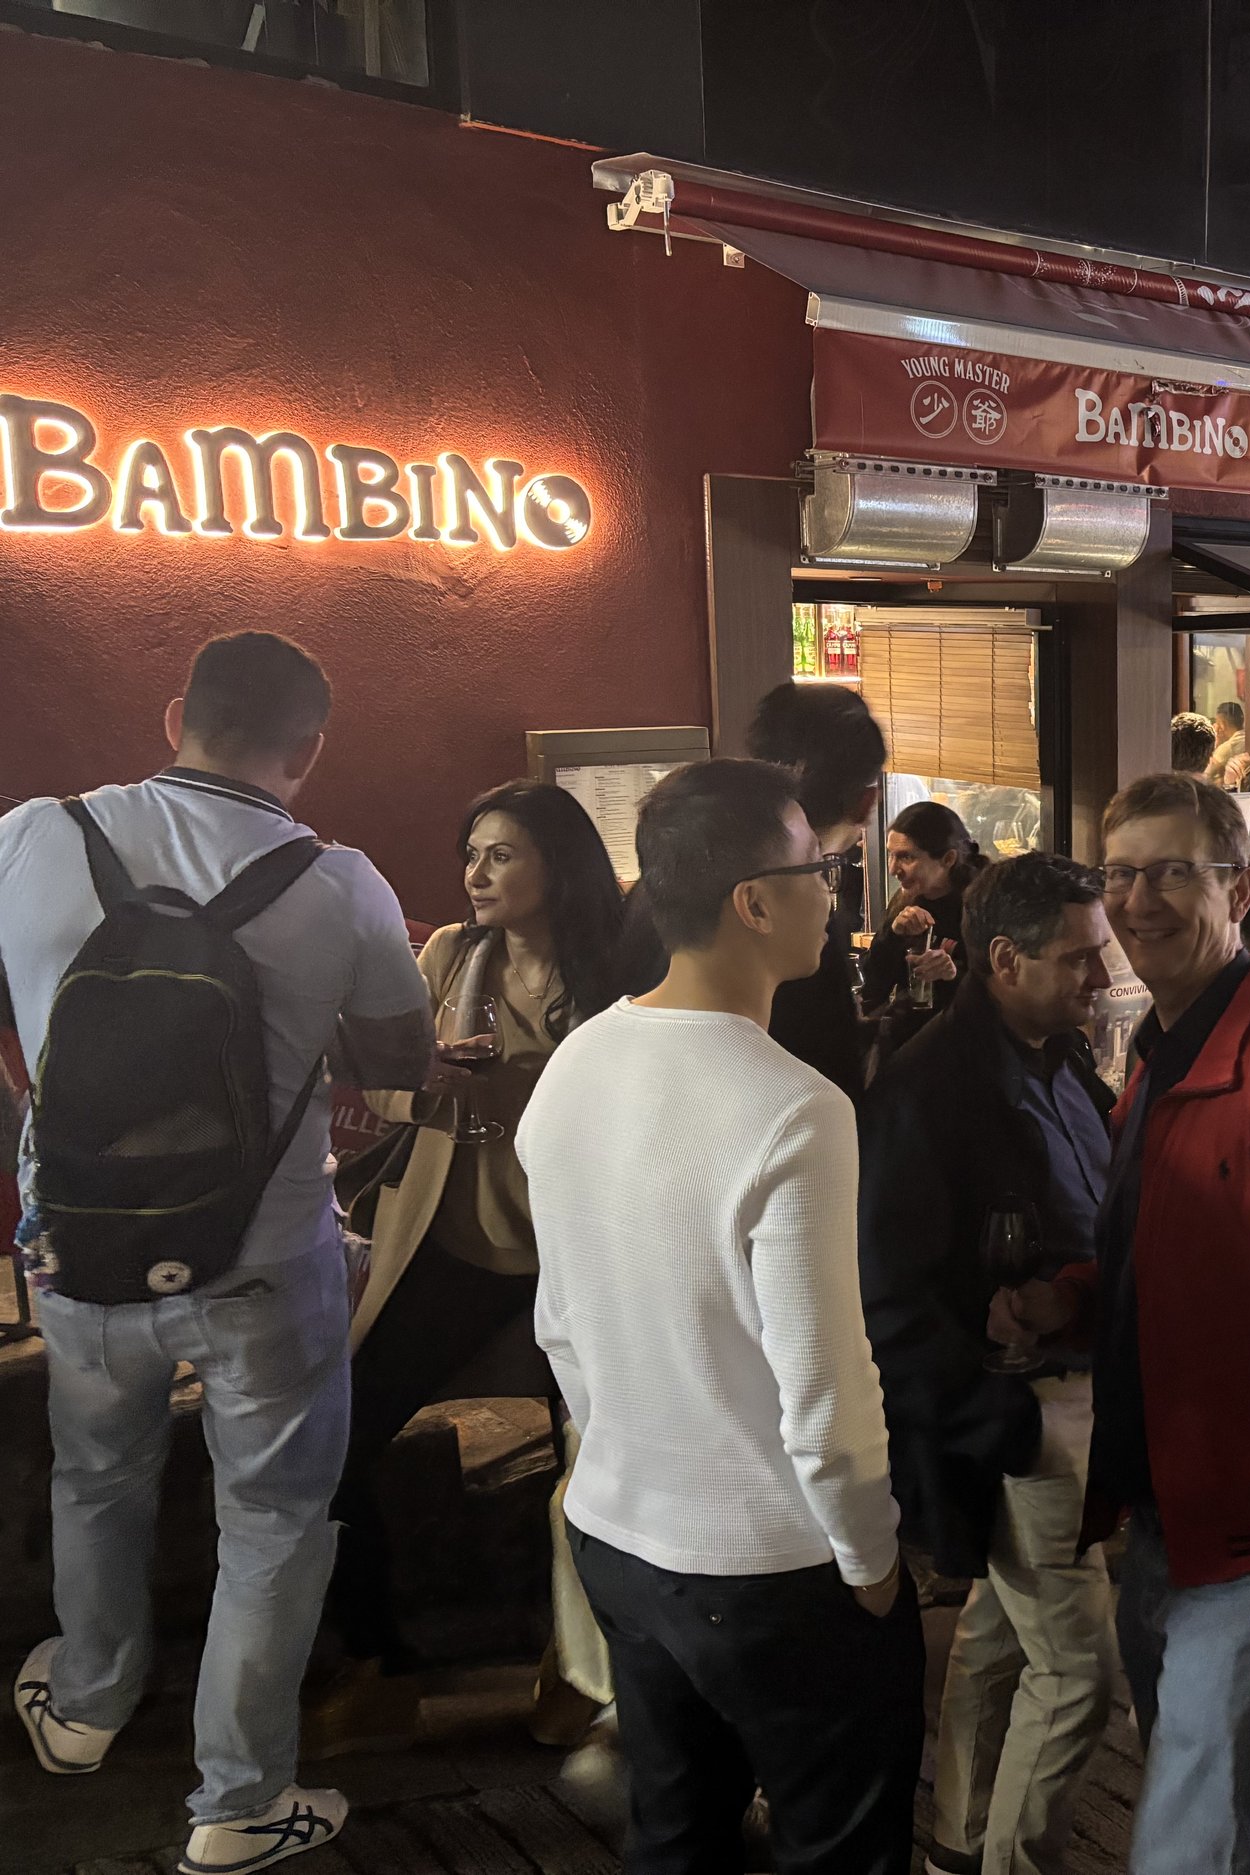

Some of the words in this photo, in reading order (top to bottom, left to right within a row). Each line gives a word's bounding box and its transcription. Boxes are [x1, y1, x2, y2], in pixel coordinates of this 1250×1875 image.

[901, 356, 950, 379] YOUNG
[954, 358, 1010, 394] MASTER
[1075, 388, 1249, 459] BAMBINO
[0, 394, 592, 550] BAMBINO
